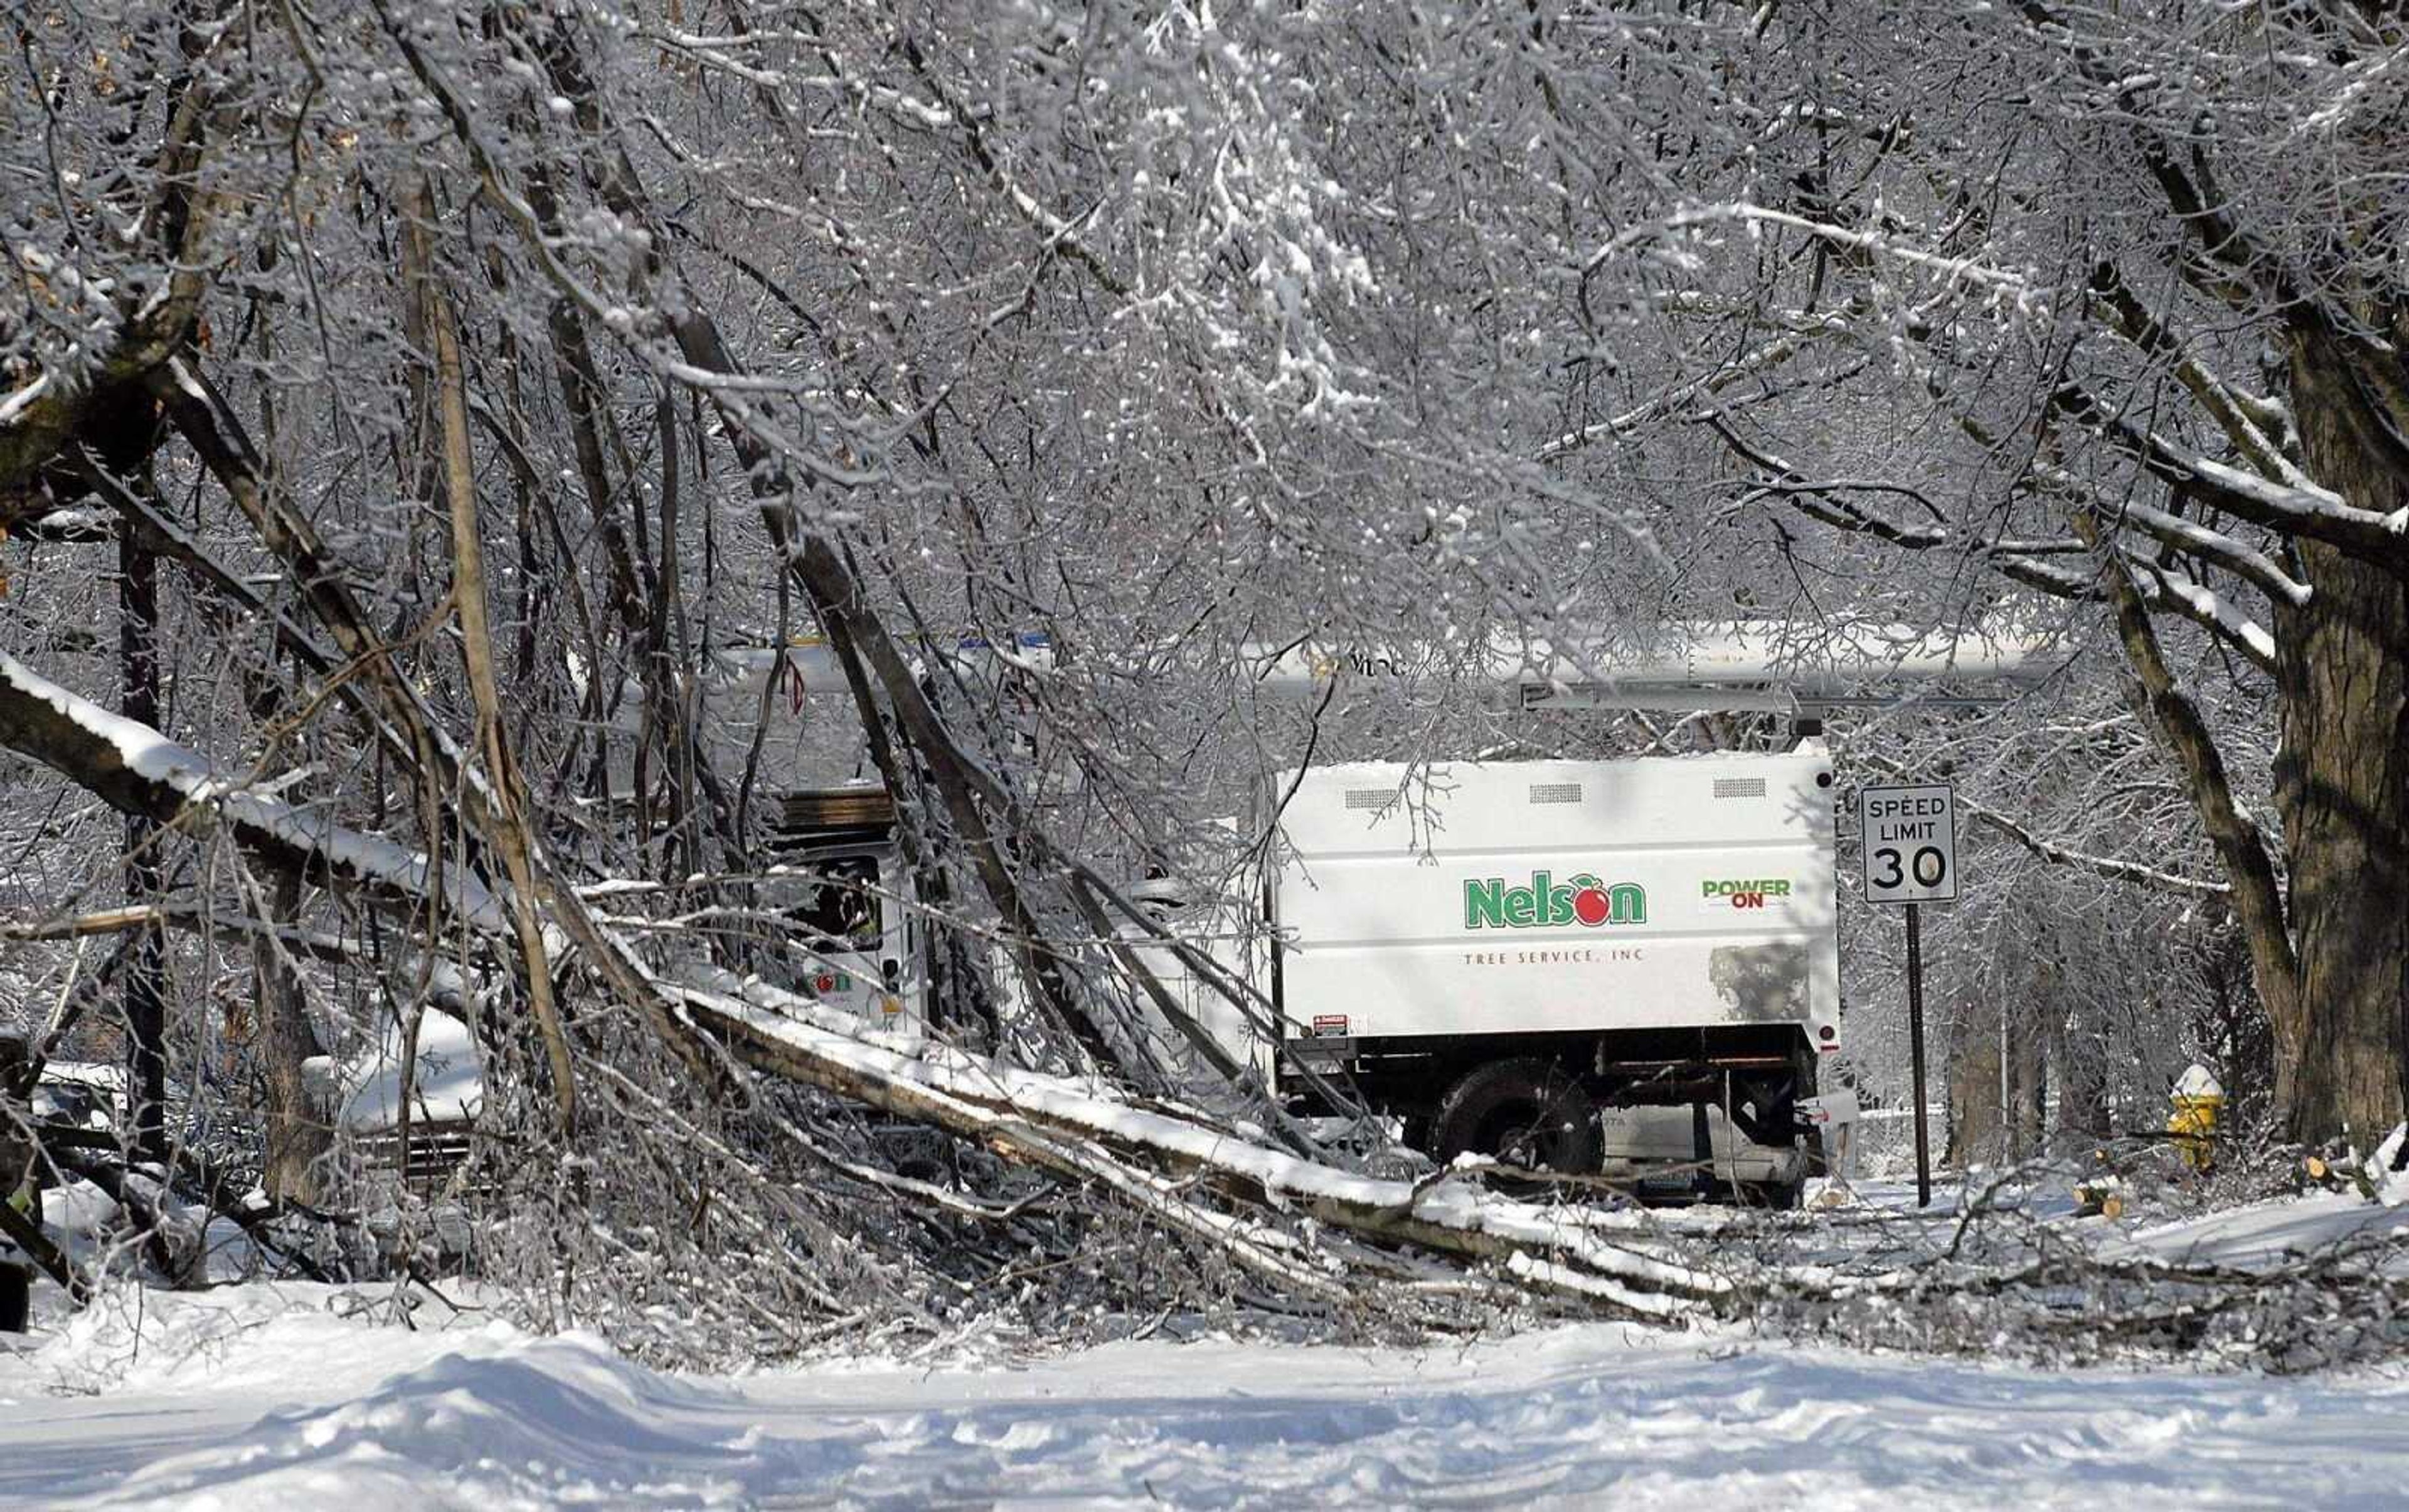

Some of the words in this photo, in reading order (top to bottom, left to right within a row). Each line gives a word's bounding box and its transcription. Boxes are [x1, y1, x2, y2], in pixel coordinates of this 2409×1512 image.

[1869, 797, 1945, 818] SPEED
[1880, 821, 1935, 841] LIMIT
[1872, 846, 1946, 889] 30
[1702, 879, 1790, 897] POWER
[1464, 870, 1646, 929] Nelson
[1731, 892, 1763, 908] ON
[1464, 952, 1506, 965] TREE
[1612, 948, 1644, 961] INC
